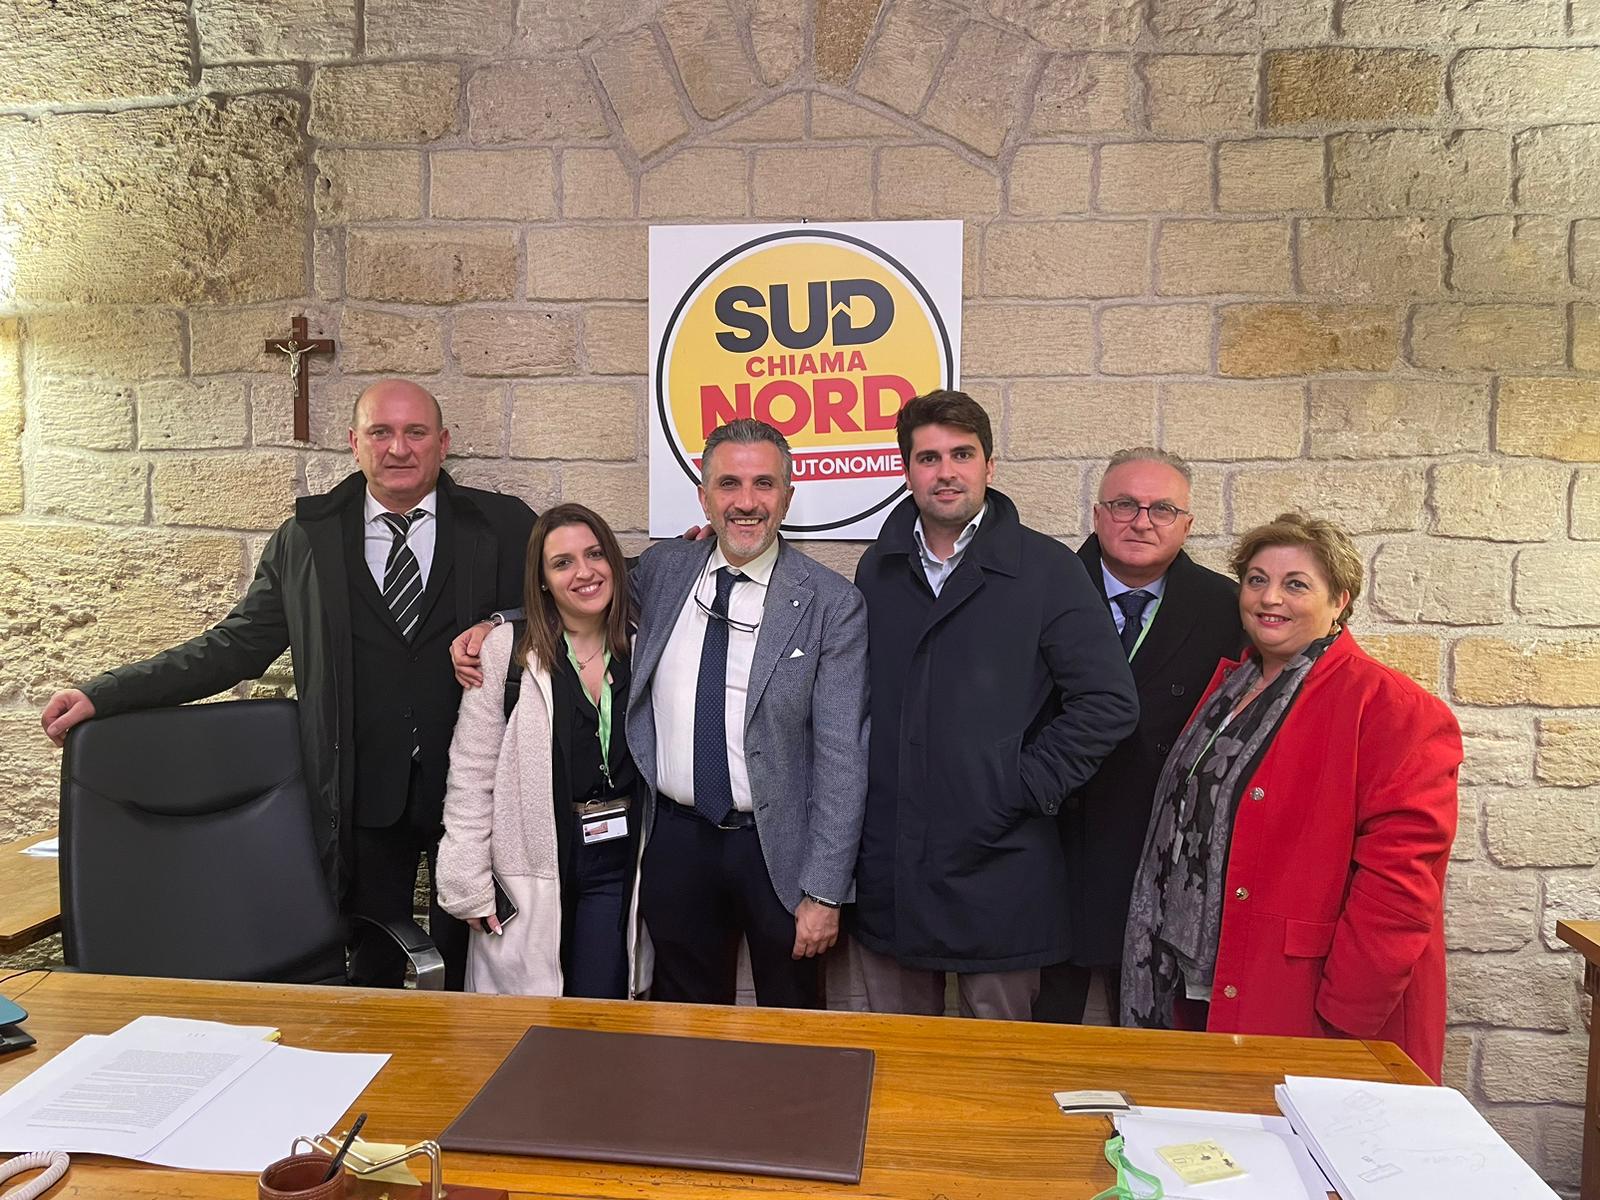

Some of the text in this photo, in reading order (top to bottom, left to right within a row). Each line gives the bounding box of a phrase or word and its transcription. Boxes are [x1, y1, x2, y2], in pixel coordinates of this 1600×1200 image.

[714, 278, 895, 353] SUD
[745, 350, 867, 377] CHIAMA
[699, 374, 917, 440] NORD
[791, 454, 903, 476] UTONOMIE
